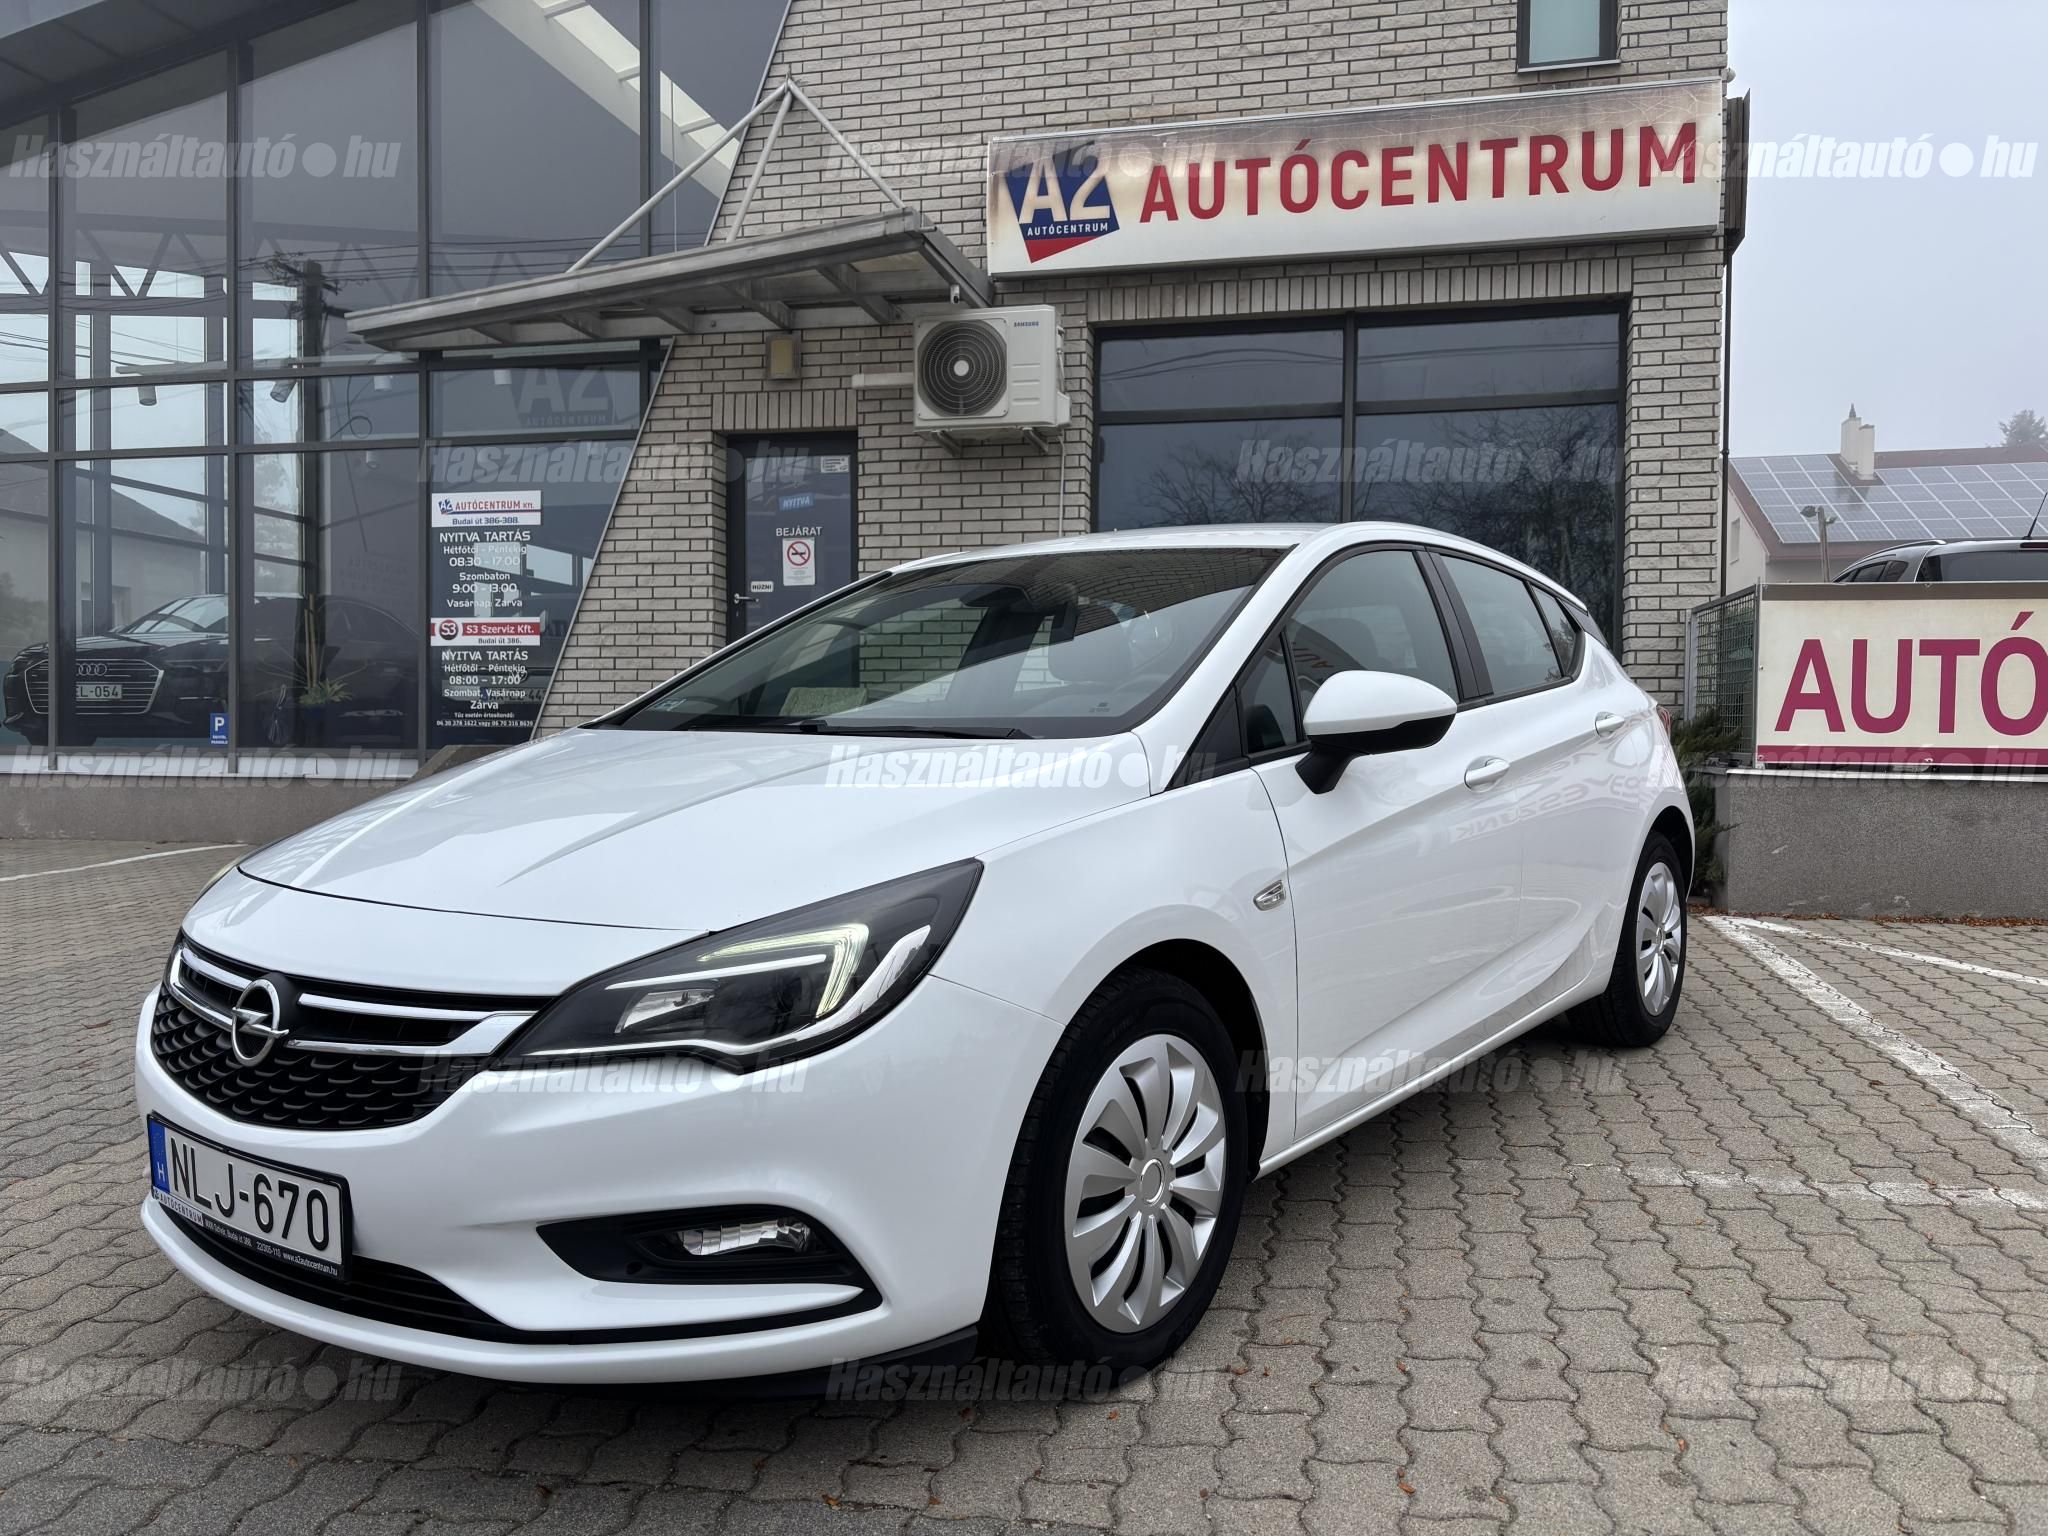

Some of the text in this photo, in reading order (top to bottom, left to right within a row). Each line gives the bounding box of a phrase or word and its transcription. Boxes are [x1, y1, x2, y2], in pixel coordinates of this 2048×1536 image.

[1019, 122, 1697, 224] A2 AUTÓCENTRUM
[1027, 222, 1108, 236] AUTÓCENTRUM
[1014, 320, 1040, 328] SAMSUNG
[455, 500, 521, 511] AUTÓCENTRUM
[475, 517, 483, 525] út
[440, 528, 531, 543] NYITVA TARTÁS
[775, 525, 823, 537] BEJÁRAT
[459, 572, 511, 581] Szombaton
[452, 583, 478, 593] 9:00
[489, 583, 517, 593] 13:00
[495, 597, 523, 608] Zárva
[441, 622, 535, 636] S3 S3 Szerviz Kft.
[441, 647, 530, 661] NYITVA TARTÁS
[444, 663, 478, 673] Hétfőtől
[488, 663, 526, 674] Péntekig
[1774, 611, 2048, 737] AUTÓ
[449, 675, 479, 685] 08:00
[491, 675, 521, 685] 17:00
[444, 688, 484, 698] Szombat,
[485, 687, 526, 699] Vasárnap
[470, 699, 499, 710] Zárva
[214, 716, 225, 733] P
[157, 1163, 166, 1182] H
[171, 1137, 330, 1251] NLJ-670
